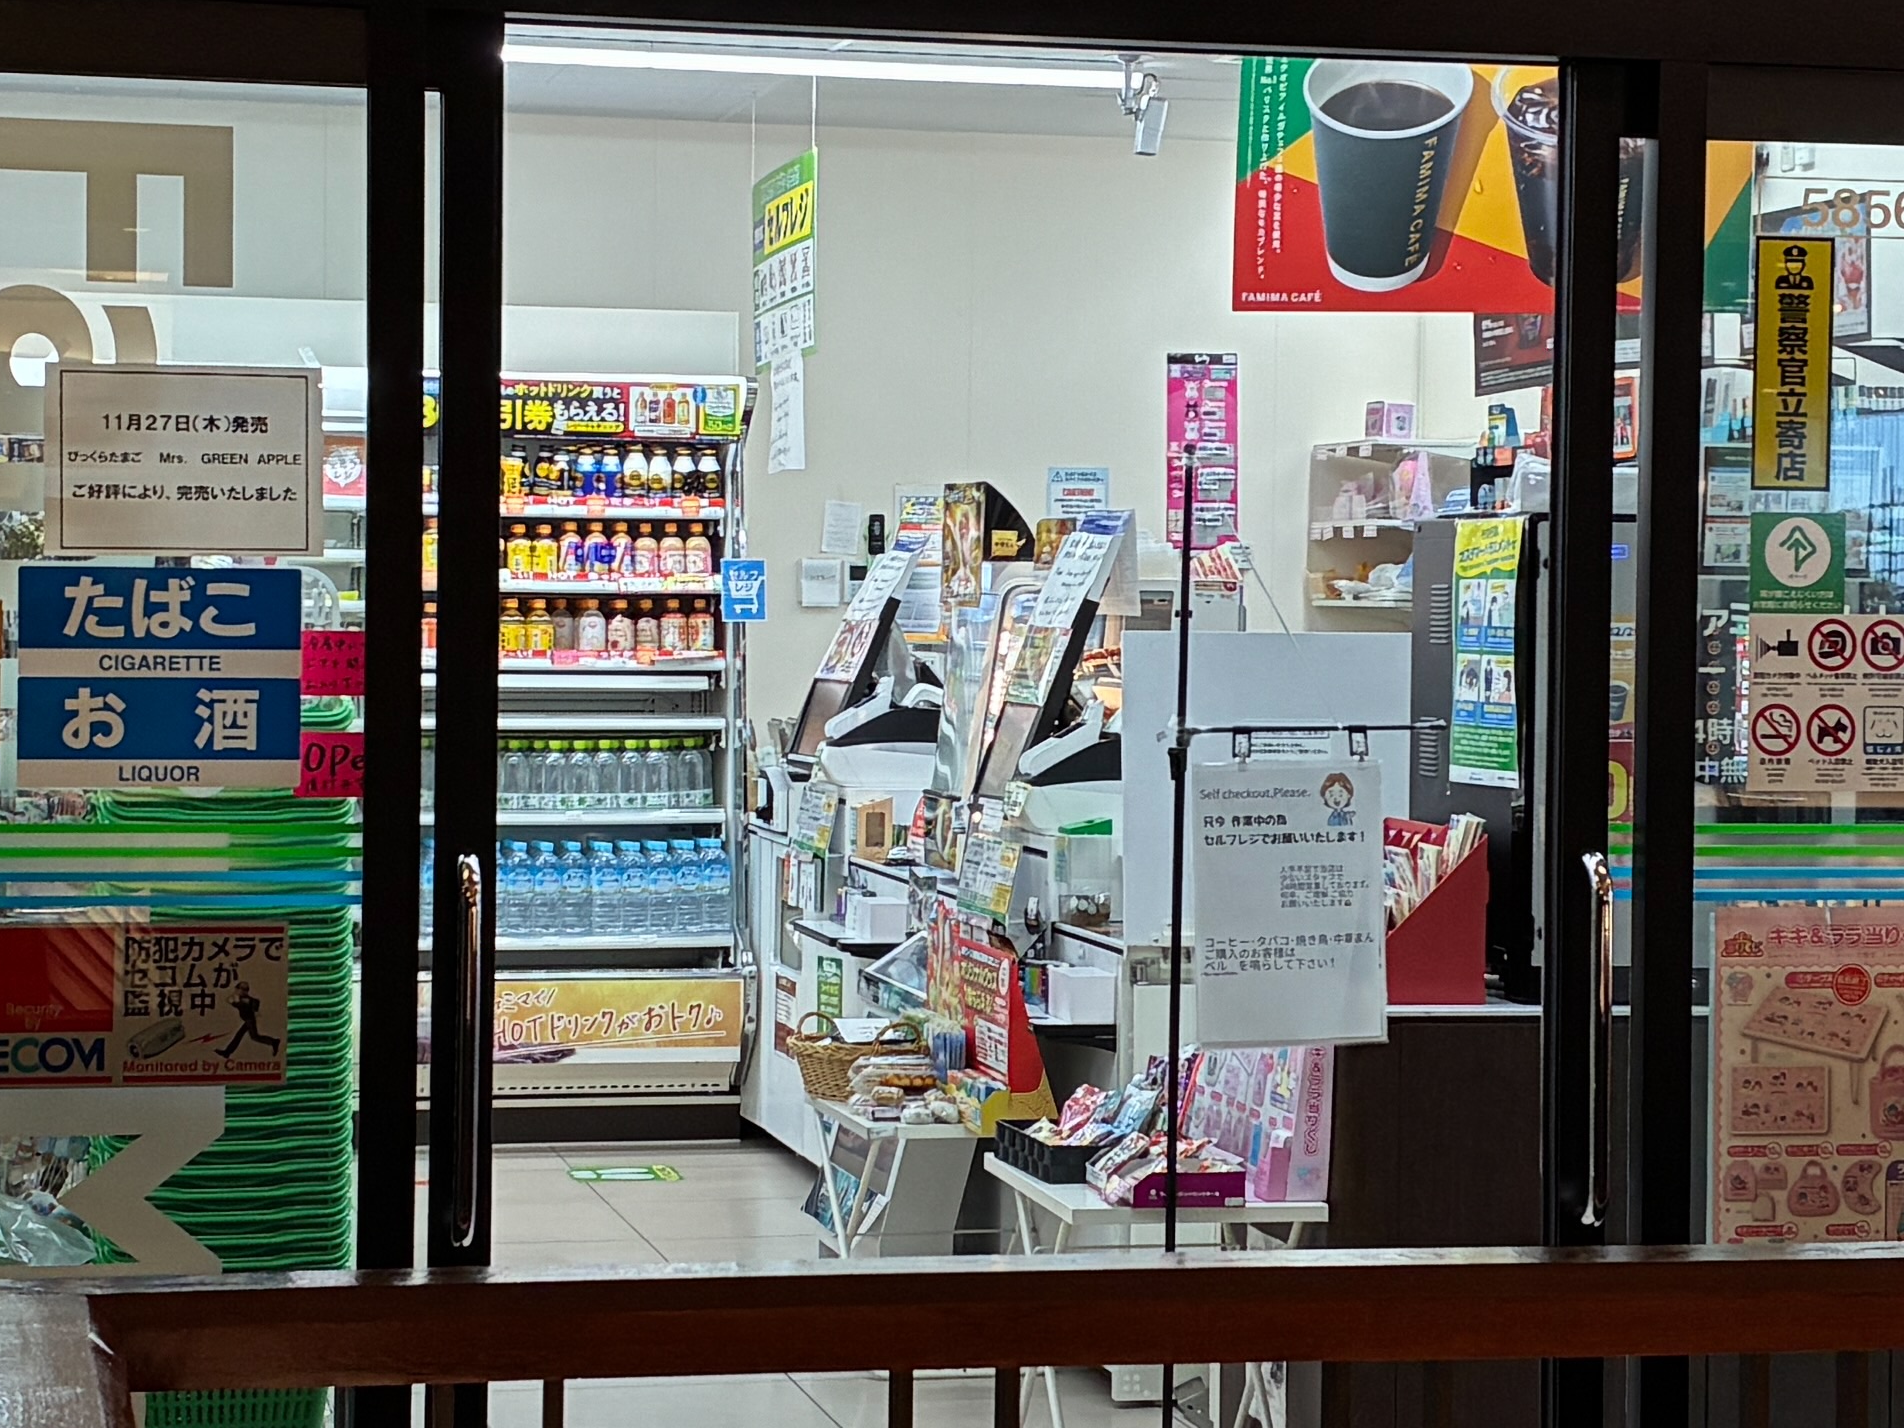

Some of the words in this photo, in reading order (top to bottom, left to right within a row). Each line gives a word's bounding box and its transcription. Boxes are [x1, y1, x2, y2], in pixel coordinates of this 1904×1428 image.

[1411, 136, 1438, 217] FAMIMA
[1241, 292, 1289, 303] FAMIMA
[1290, 289, 1322, 303] CAFÉ
[1774, 292, 1812, 482] 警察官立寄店
[101, 413, 269, 435] 11月27日(木)発売
[159, 452, 187, 464] Mrs.
[201, 453, 249, 465] GREEN
[257, 454, 302, 466] APPLE
[71, 484, 298, 502] ご好評により、完売いたしました
[728, 569, 759, 582] セルフ
[735, 582, 752, 592] レジ
[62, 575, 256, 639] たばこ
[98, 654, 222, 672] CIGARETTE
[118, 765, 200, 783] LIQUOR
[1199, 788, 1221, 800] Self
[1203, 816, 1225, 828] 只今
[124, 936, 284, 964] 防犯カメラで
[1204, 948, 1296, 960] ご購入のお客様は
[1204, 961, 1227, 971] ベル
[123, 963, 238, 989] セコムが
[122, 988, 216, 1017] 監視中
[123, 1060, 198, 1072] Monitored
[202, 1060, 220, 1075] by
[224, 1059, 281, 1072] Camera
